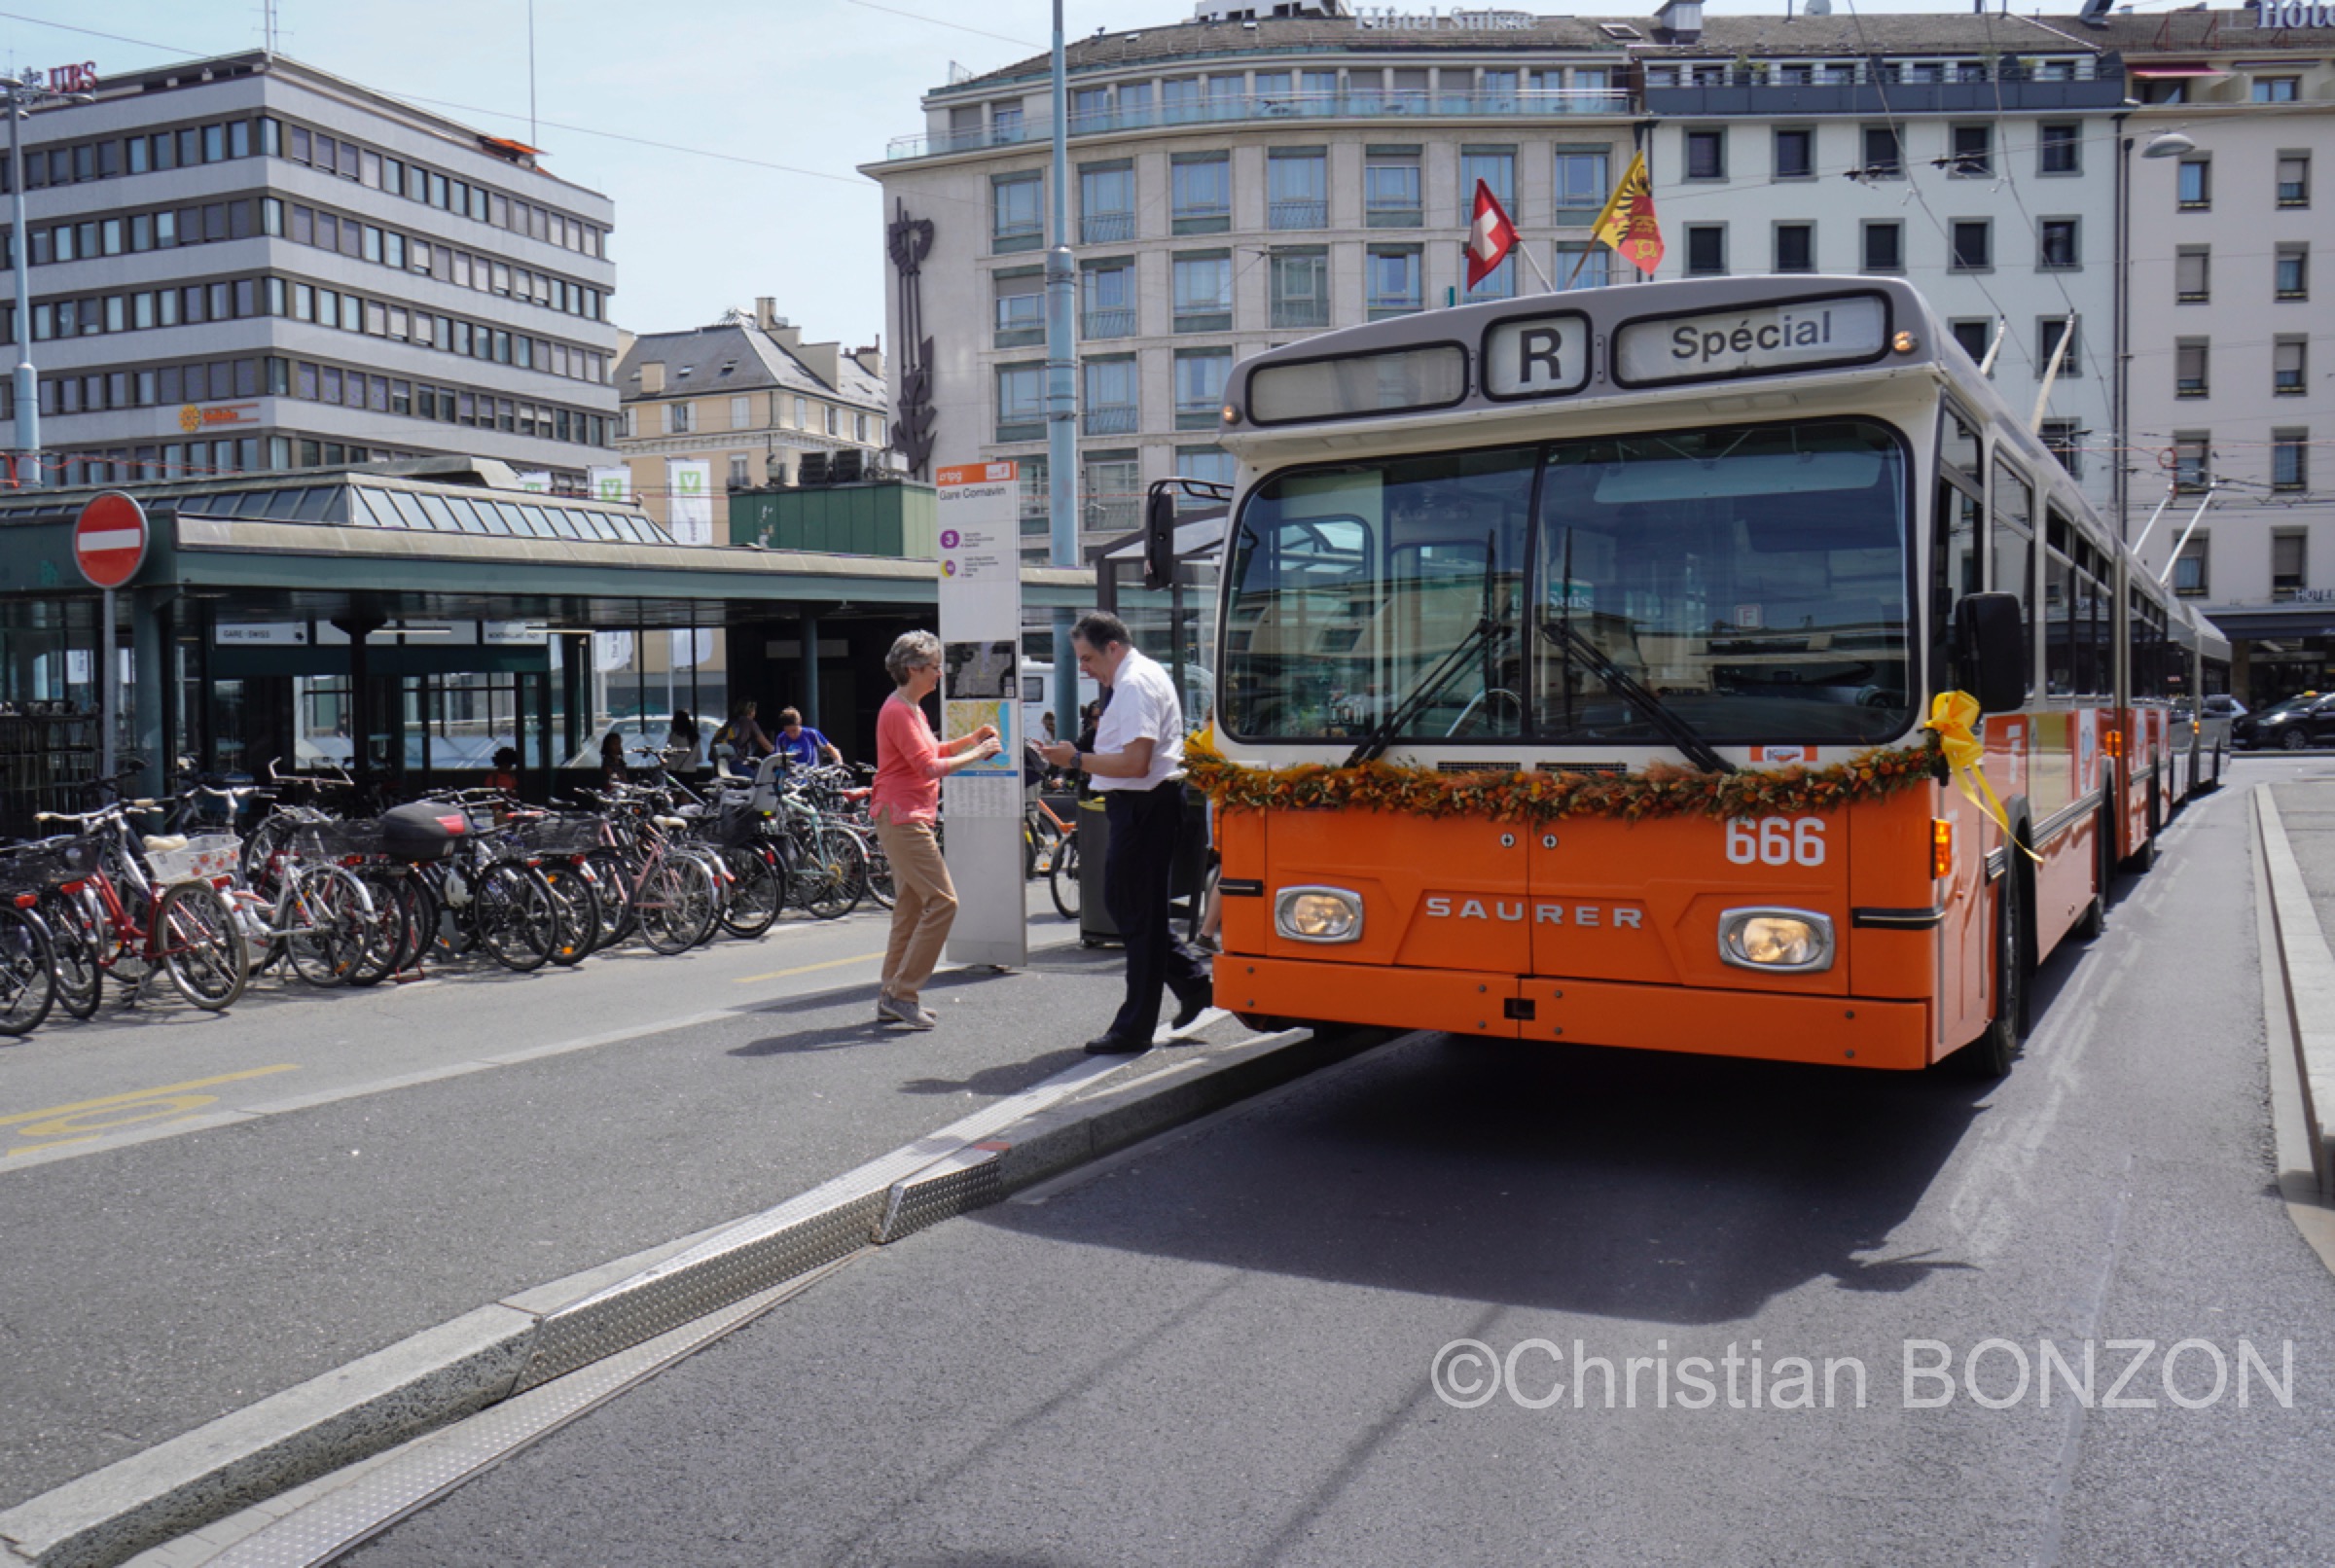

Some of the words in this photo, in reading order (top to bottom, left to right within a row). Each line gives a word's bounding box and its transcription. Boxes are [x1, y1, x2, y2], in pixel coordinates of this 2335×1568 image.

[1355, 6, 1438, 30] Hôtel
[1449, 7, 1539, 30] Suisse
[48, 60, 95, 93] UBS
[1520, 327, 1562, 383] R
[1671, 310, 1831, 363] Spécial
[1725, 816, 1826, 867] 666
[1426, 898, 1643, 929] SAURER
